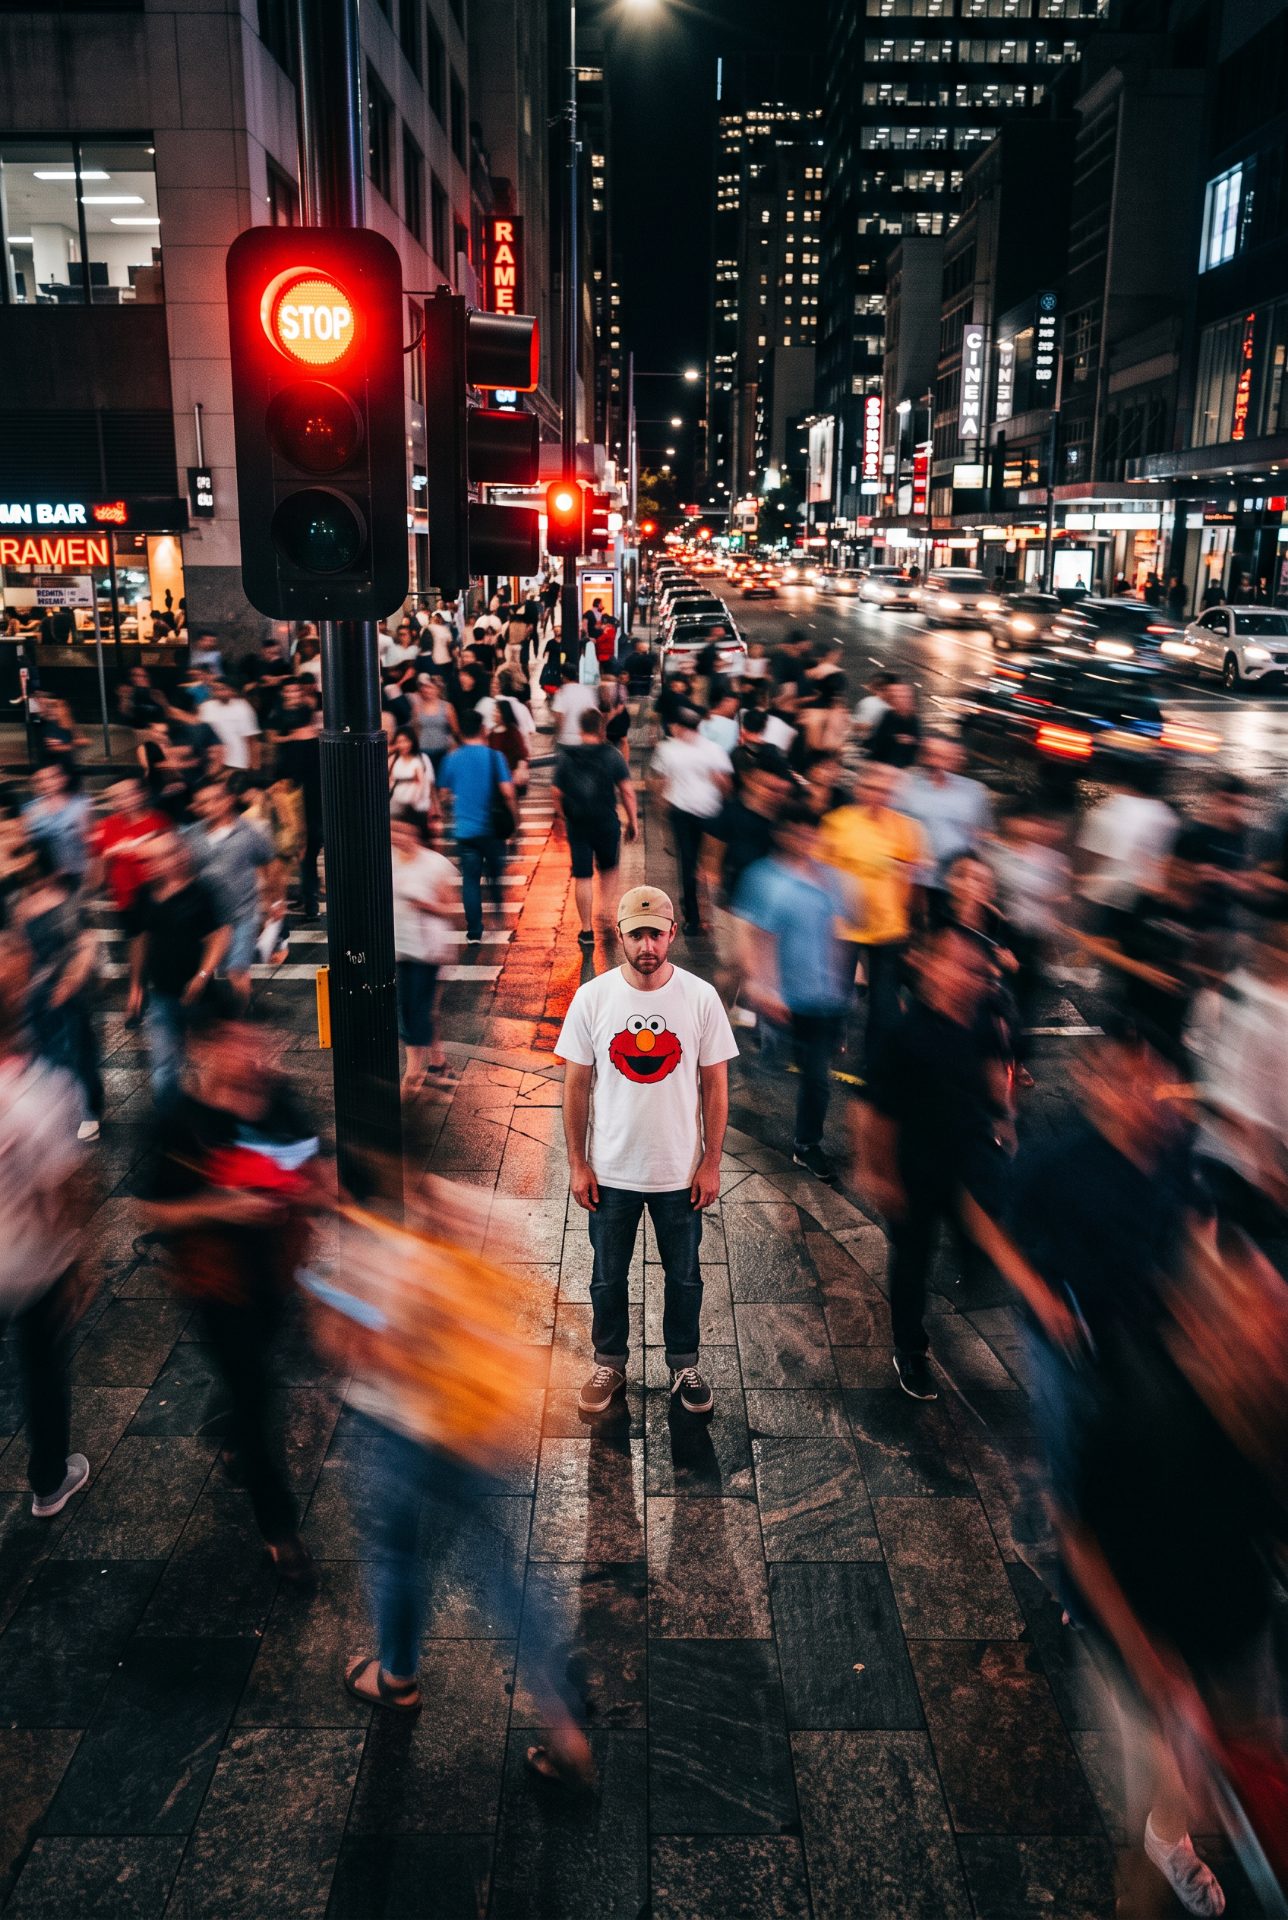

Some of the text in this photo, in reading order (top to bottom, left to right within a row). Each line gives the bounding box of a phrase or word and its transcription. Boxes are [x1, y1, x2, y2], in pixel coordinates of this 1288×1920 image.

[494, 222, 515, 315] RAME
[281, 304, 351, 341] STOP
[962, 332, 982, 435] CINEMA
[36, 503, 87, 524] BAR
[1, 538, 109, 565] RAMEN
